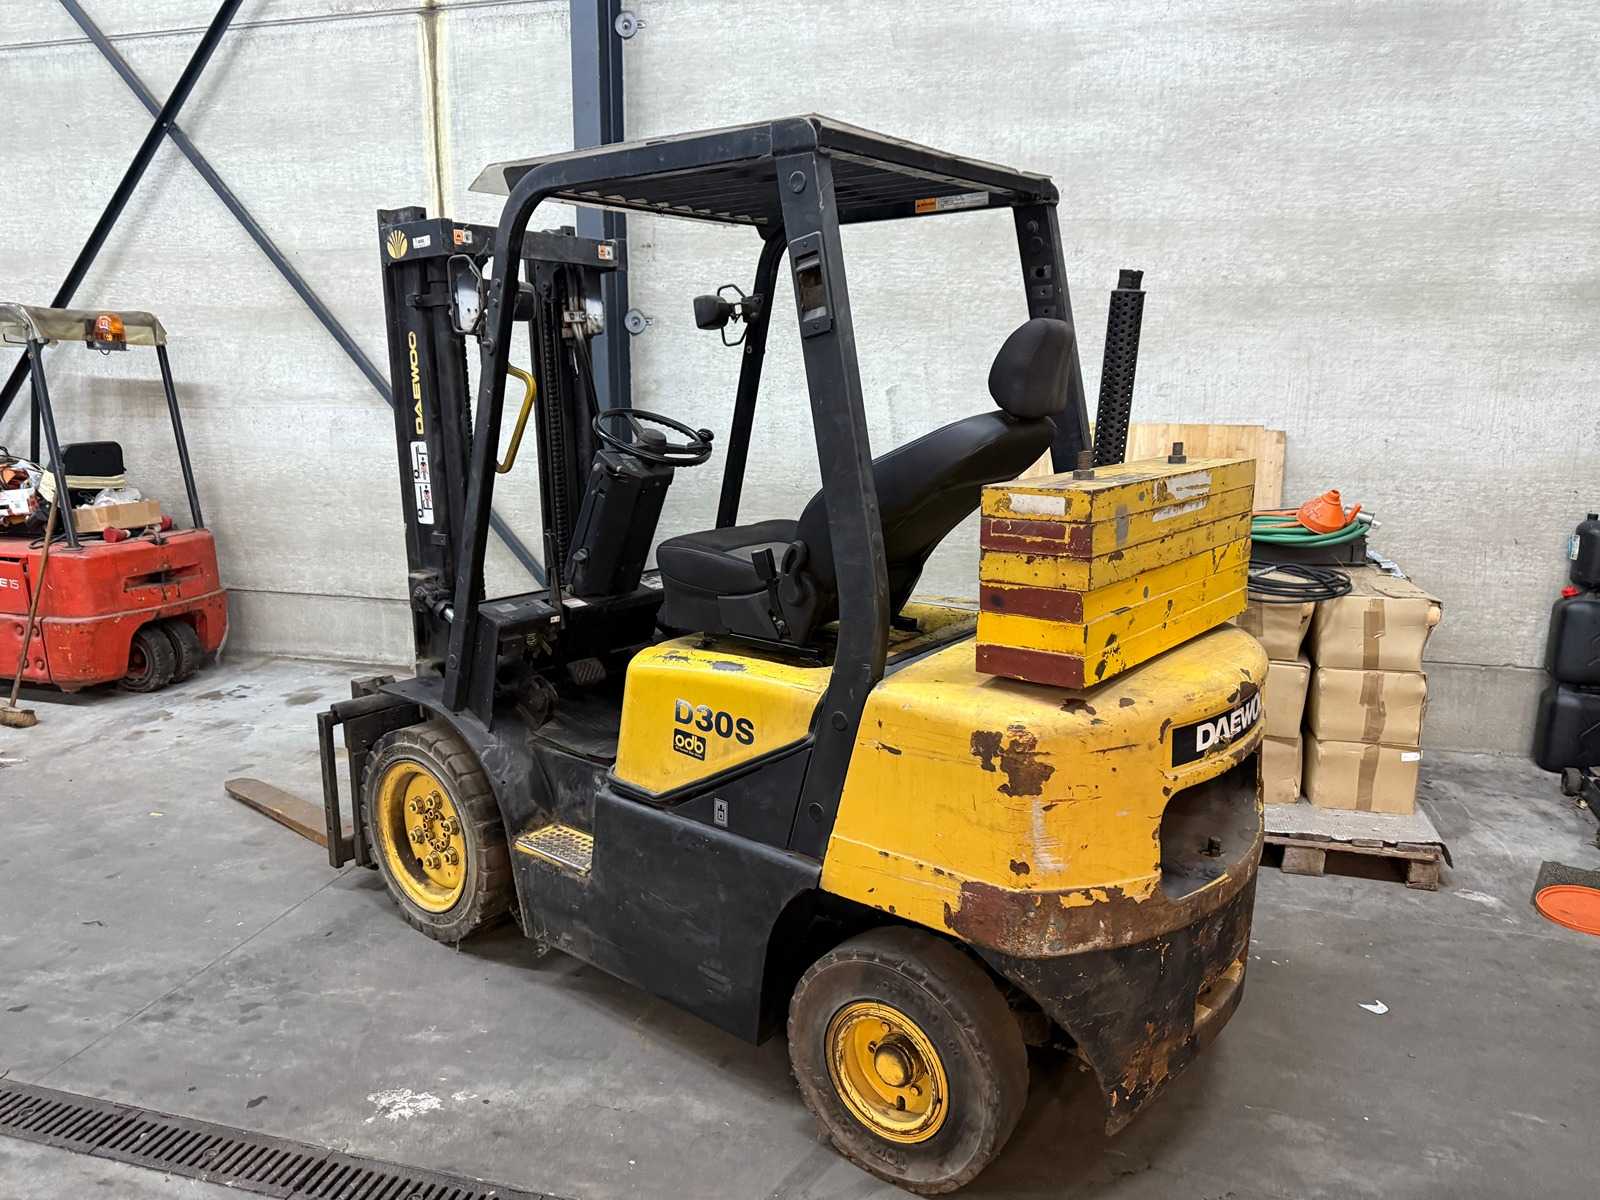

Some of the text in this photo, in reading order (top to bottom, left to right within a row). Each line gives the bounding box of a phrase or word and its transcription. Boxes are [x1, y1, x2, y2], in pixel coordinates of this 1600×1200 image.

[408, 331, 424, 435] DAEWOO
[675, 698, 755, 746] D30S
[1195, 692, 1262, 753] DAEWO
